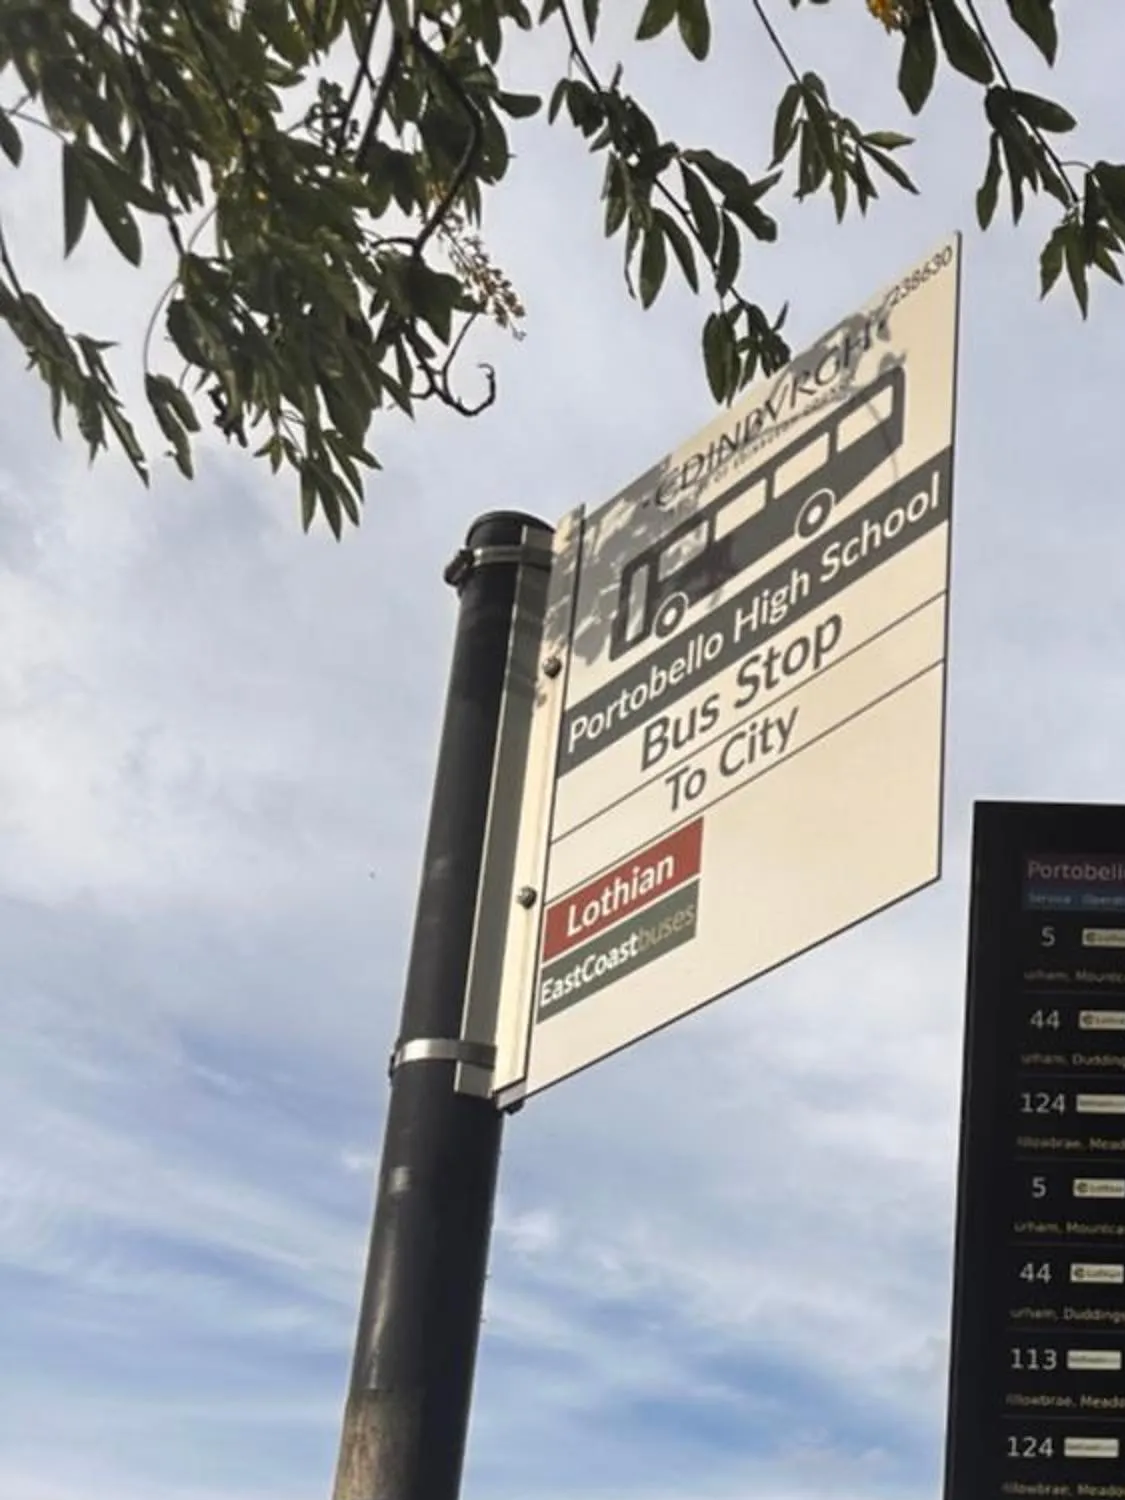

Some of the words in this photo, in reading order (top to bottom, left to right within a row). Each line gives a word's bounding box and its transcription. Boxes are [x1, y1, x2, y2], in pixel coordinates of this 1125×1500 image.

[567, 638, 725, 754] Portobello
[733, 567, 811, 645] High
[820, 471, 941, 583] School
[640, 693, 720, 772] Bus
[733, 614, 843, 708] Stop
[664, 767, 707, 812] To
[719, 706, 799, 779] City
[566, 854, 675, 937] Lothian
[1041, 926, 1056, 947] 5
[1030, 1009, 1060, 1029] 44
[1022, 1092, 1066, 1113] 124
[1032, 1176, 1047, 1199] 5
[1019, 1263, 1052, 1283] 44
[1011, 1348, 1057, 1371] 113
[1007, 1436, 1054, 1458] 124
